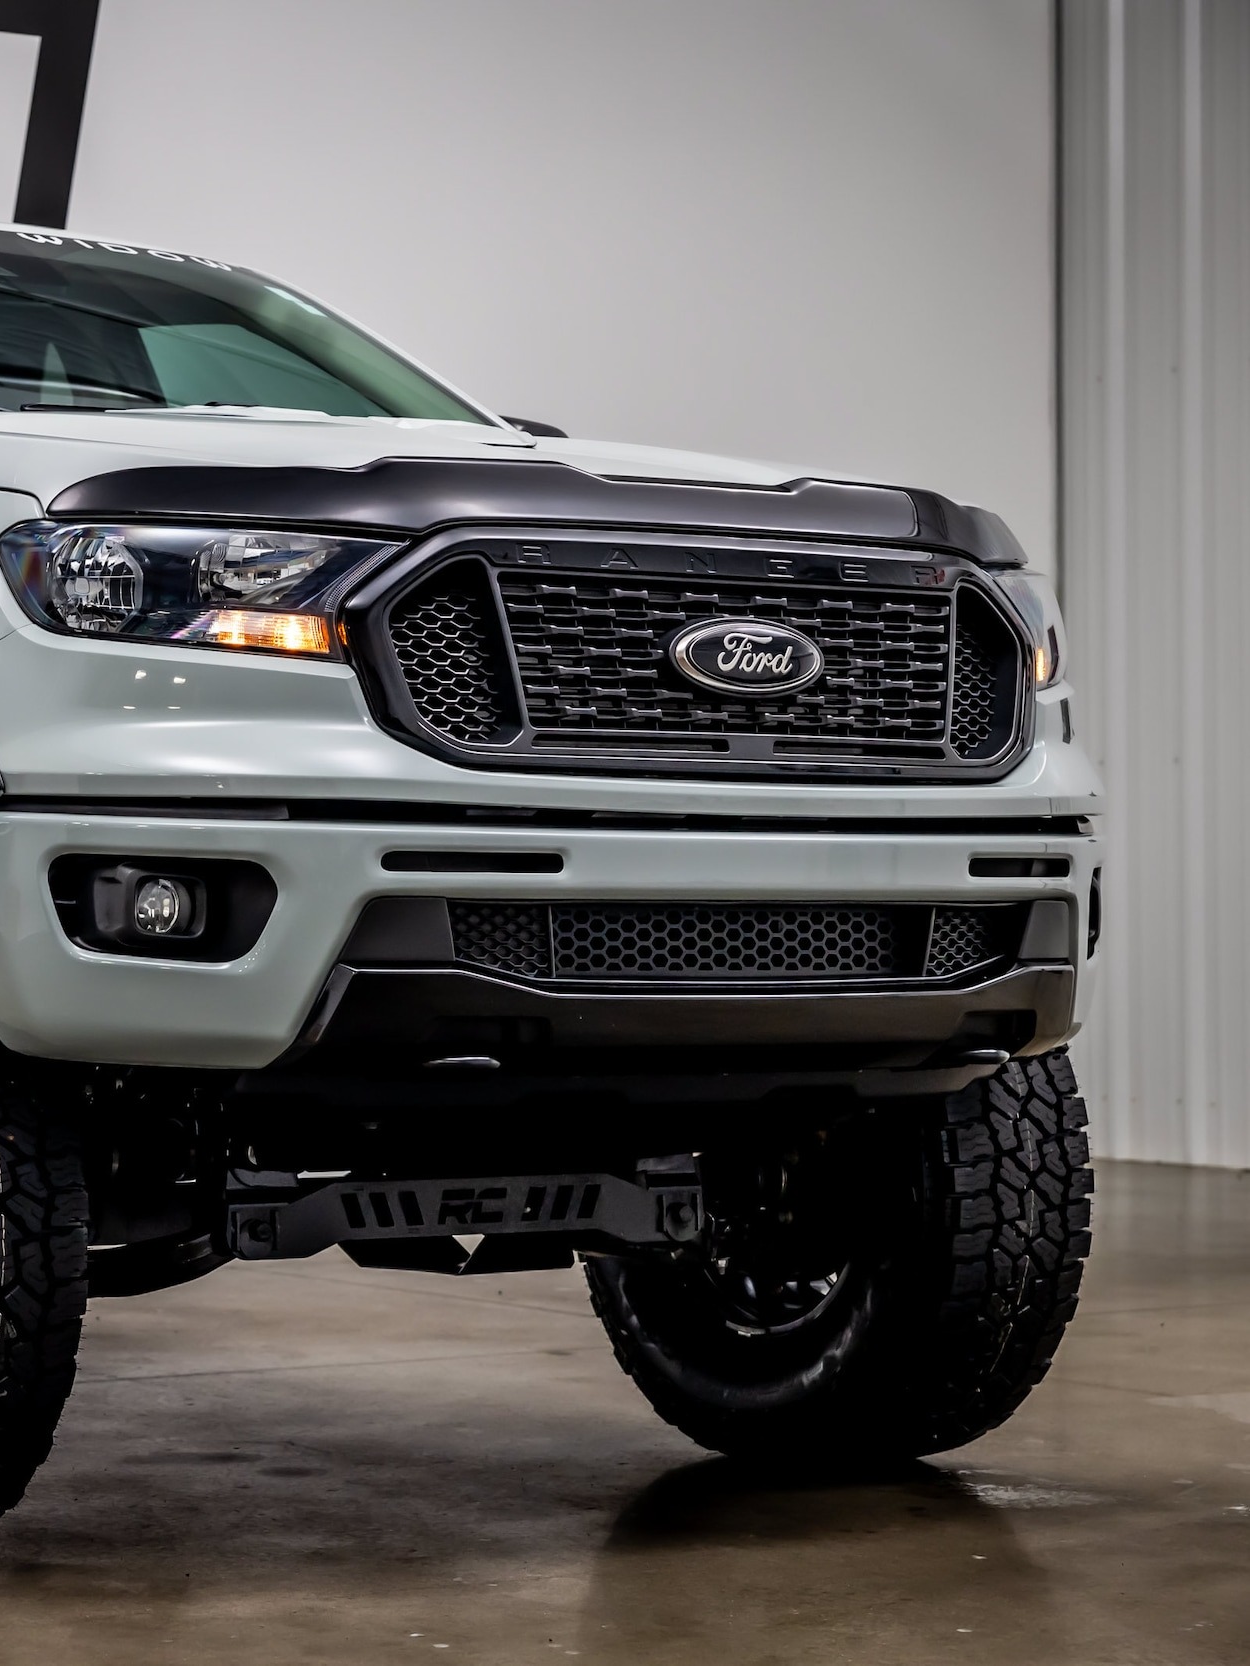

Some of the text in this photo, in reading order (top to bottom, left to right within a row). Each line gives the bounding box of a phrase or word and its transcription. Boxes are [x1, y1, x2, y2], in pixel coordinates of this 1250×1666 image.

[16, 232, 233, 272] WIDOW
[516, 543, 946, 586] RANGER
[717, 632, 794, 676] Ford
[437, 1186, 508, 1225] RC
